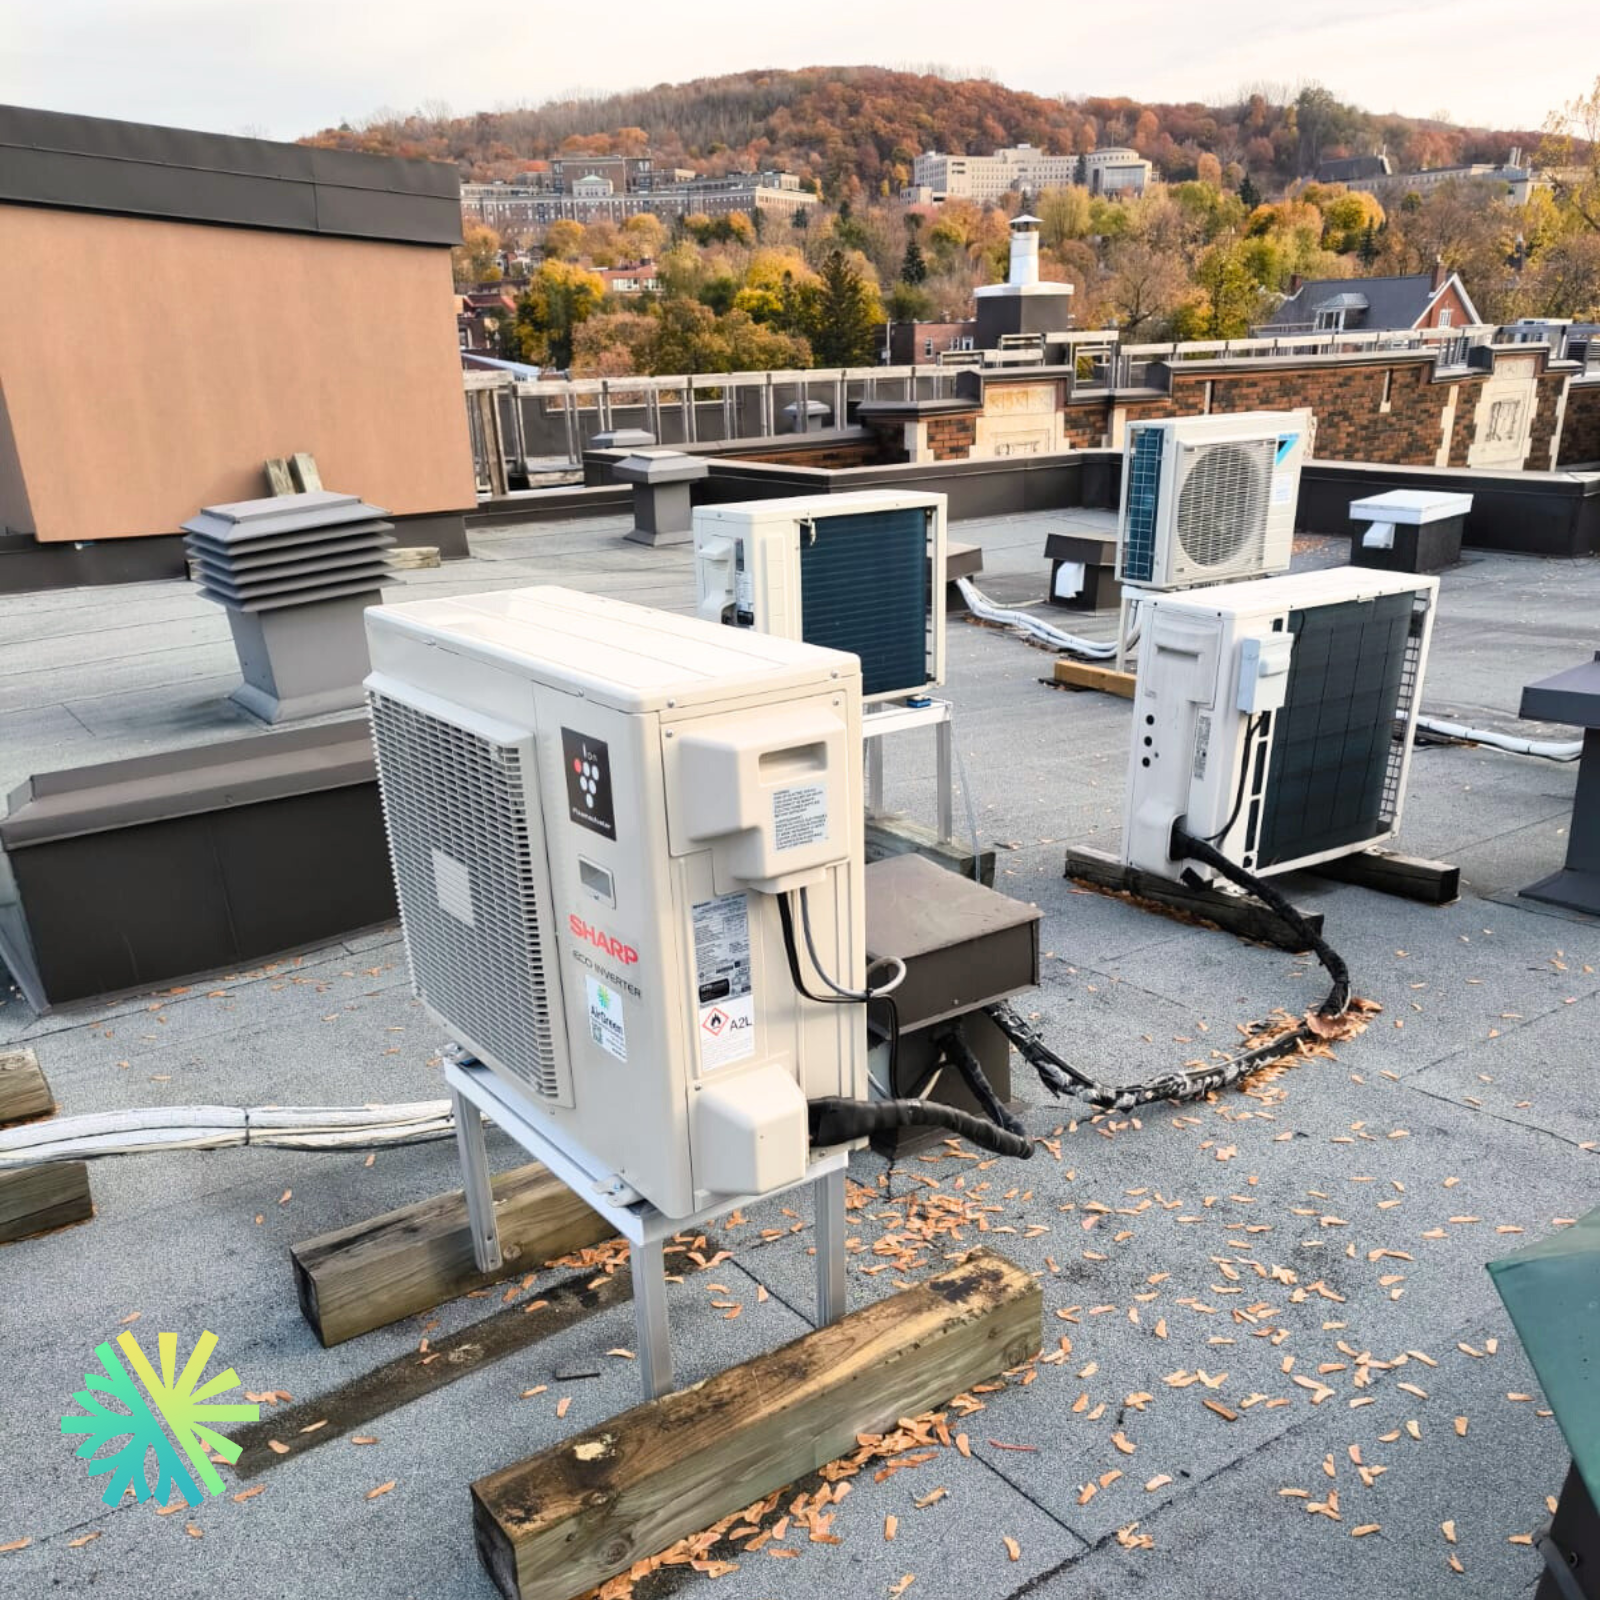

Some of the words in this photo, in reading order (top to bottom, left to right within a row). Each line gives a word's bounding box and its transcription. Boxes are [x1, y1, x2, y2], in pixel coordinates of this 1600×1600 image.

[569, 913, 639, 965] SHARP
[572, 949, 593, 970] ECO
[594, 963, 642, 999] INVERTER
[591, 1005, 624, 1035] AirGreen
[730, 1015, 753, 1032] A2L
